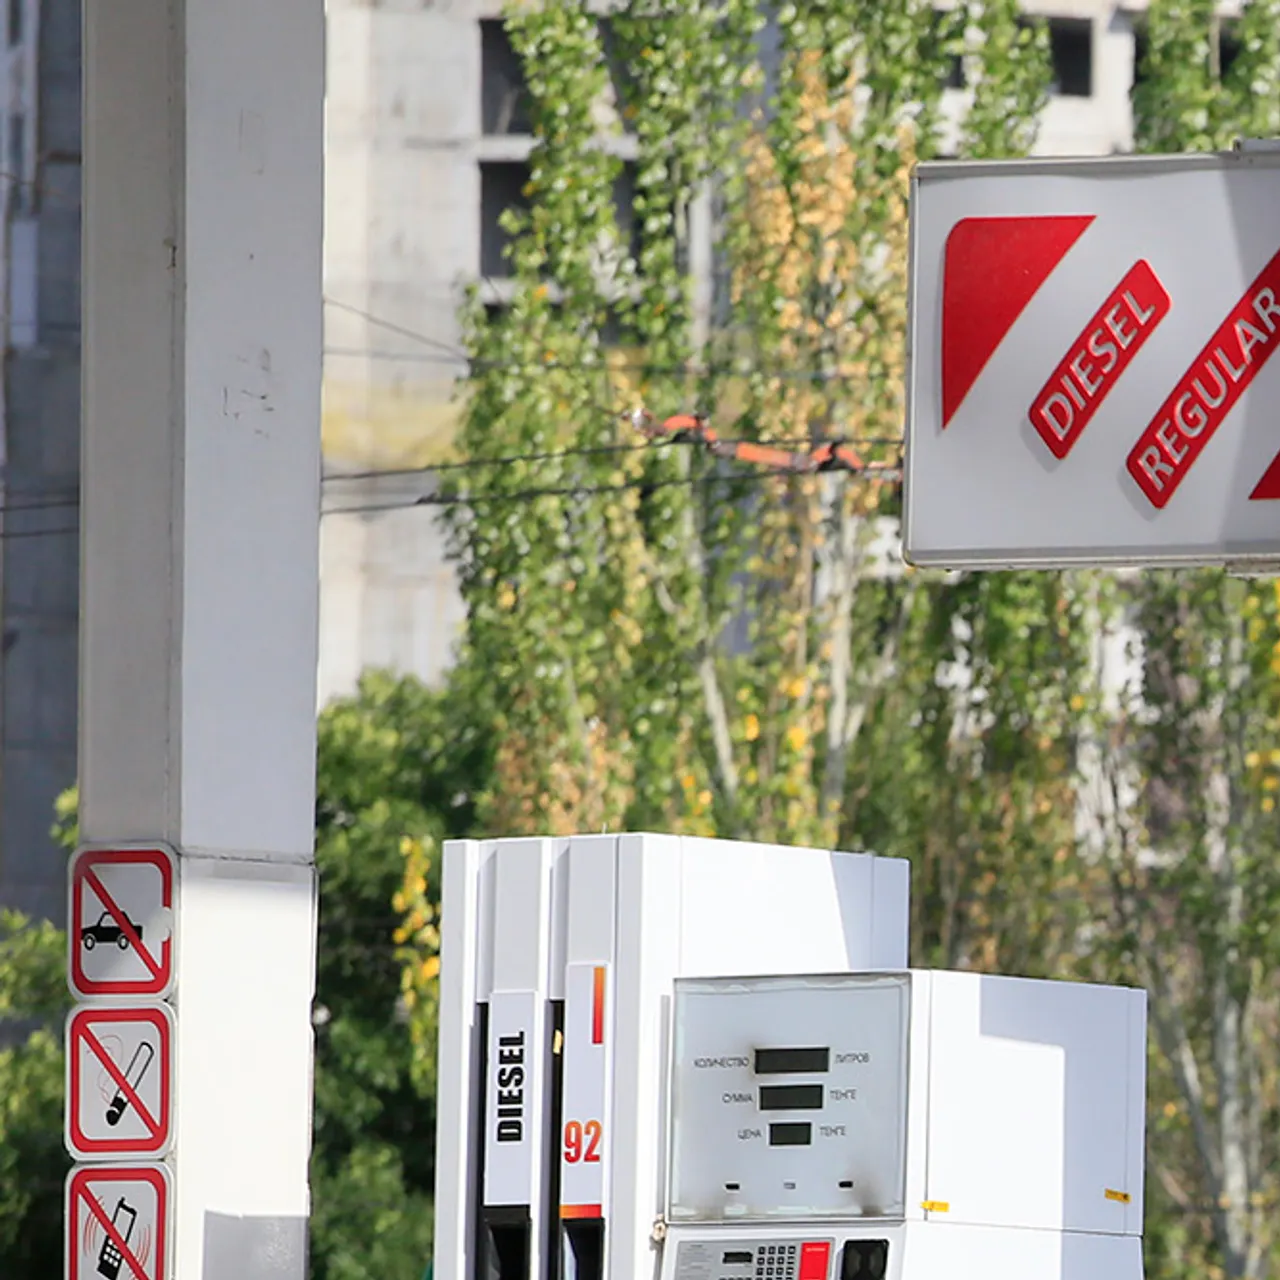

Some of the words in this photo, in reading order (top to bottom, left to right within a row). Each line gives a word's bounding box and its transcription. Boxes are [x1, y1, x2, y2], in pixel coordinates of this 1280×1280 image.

[1039, 290, 1155, 441] DIESEL
[497, 1031, 525, 1142] DIESEL
[563, 1119, 602, 1163] 92
